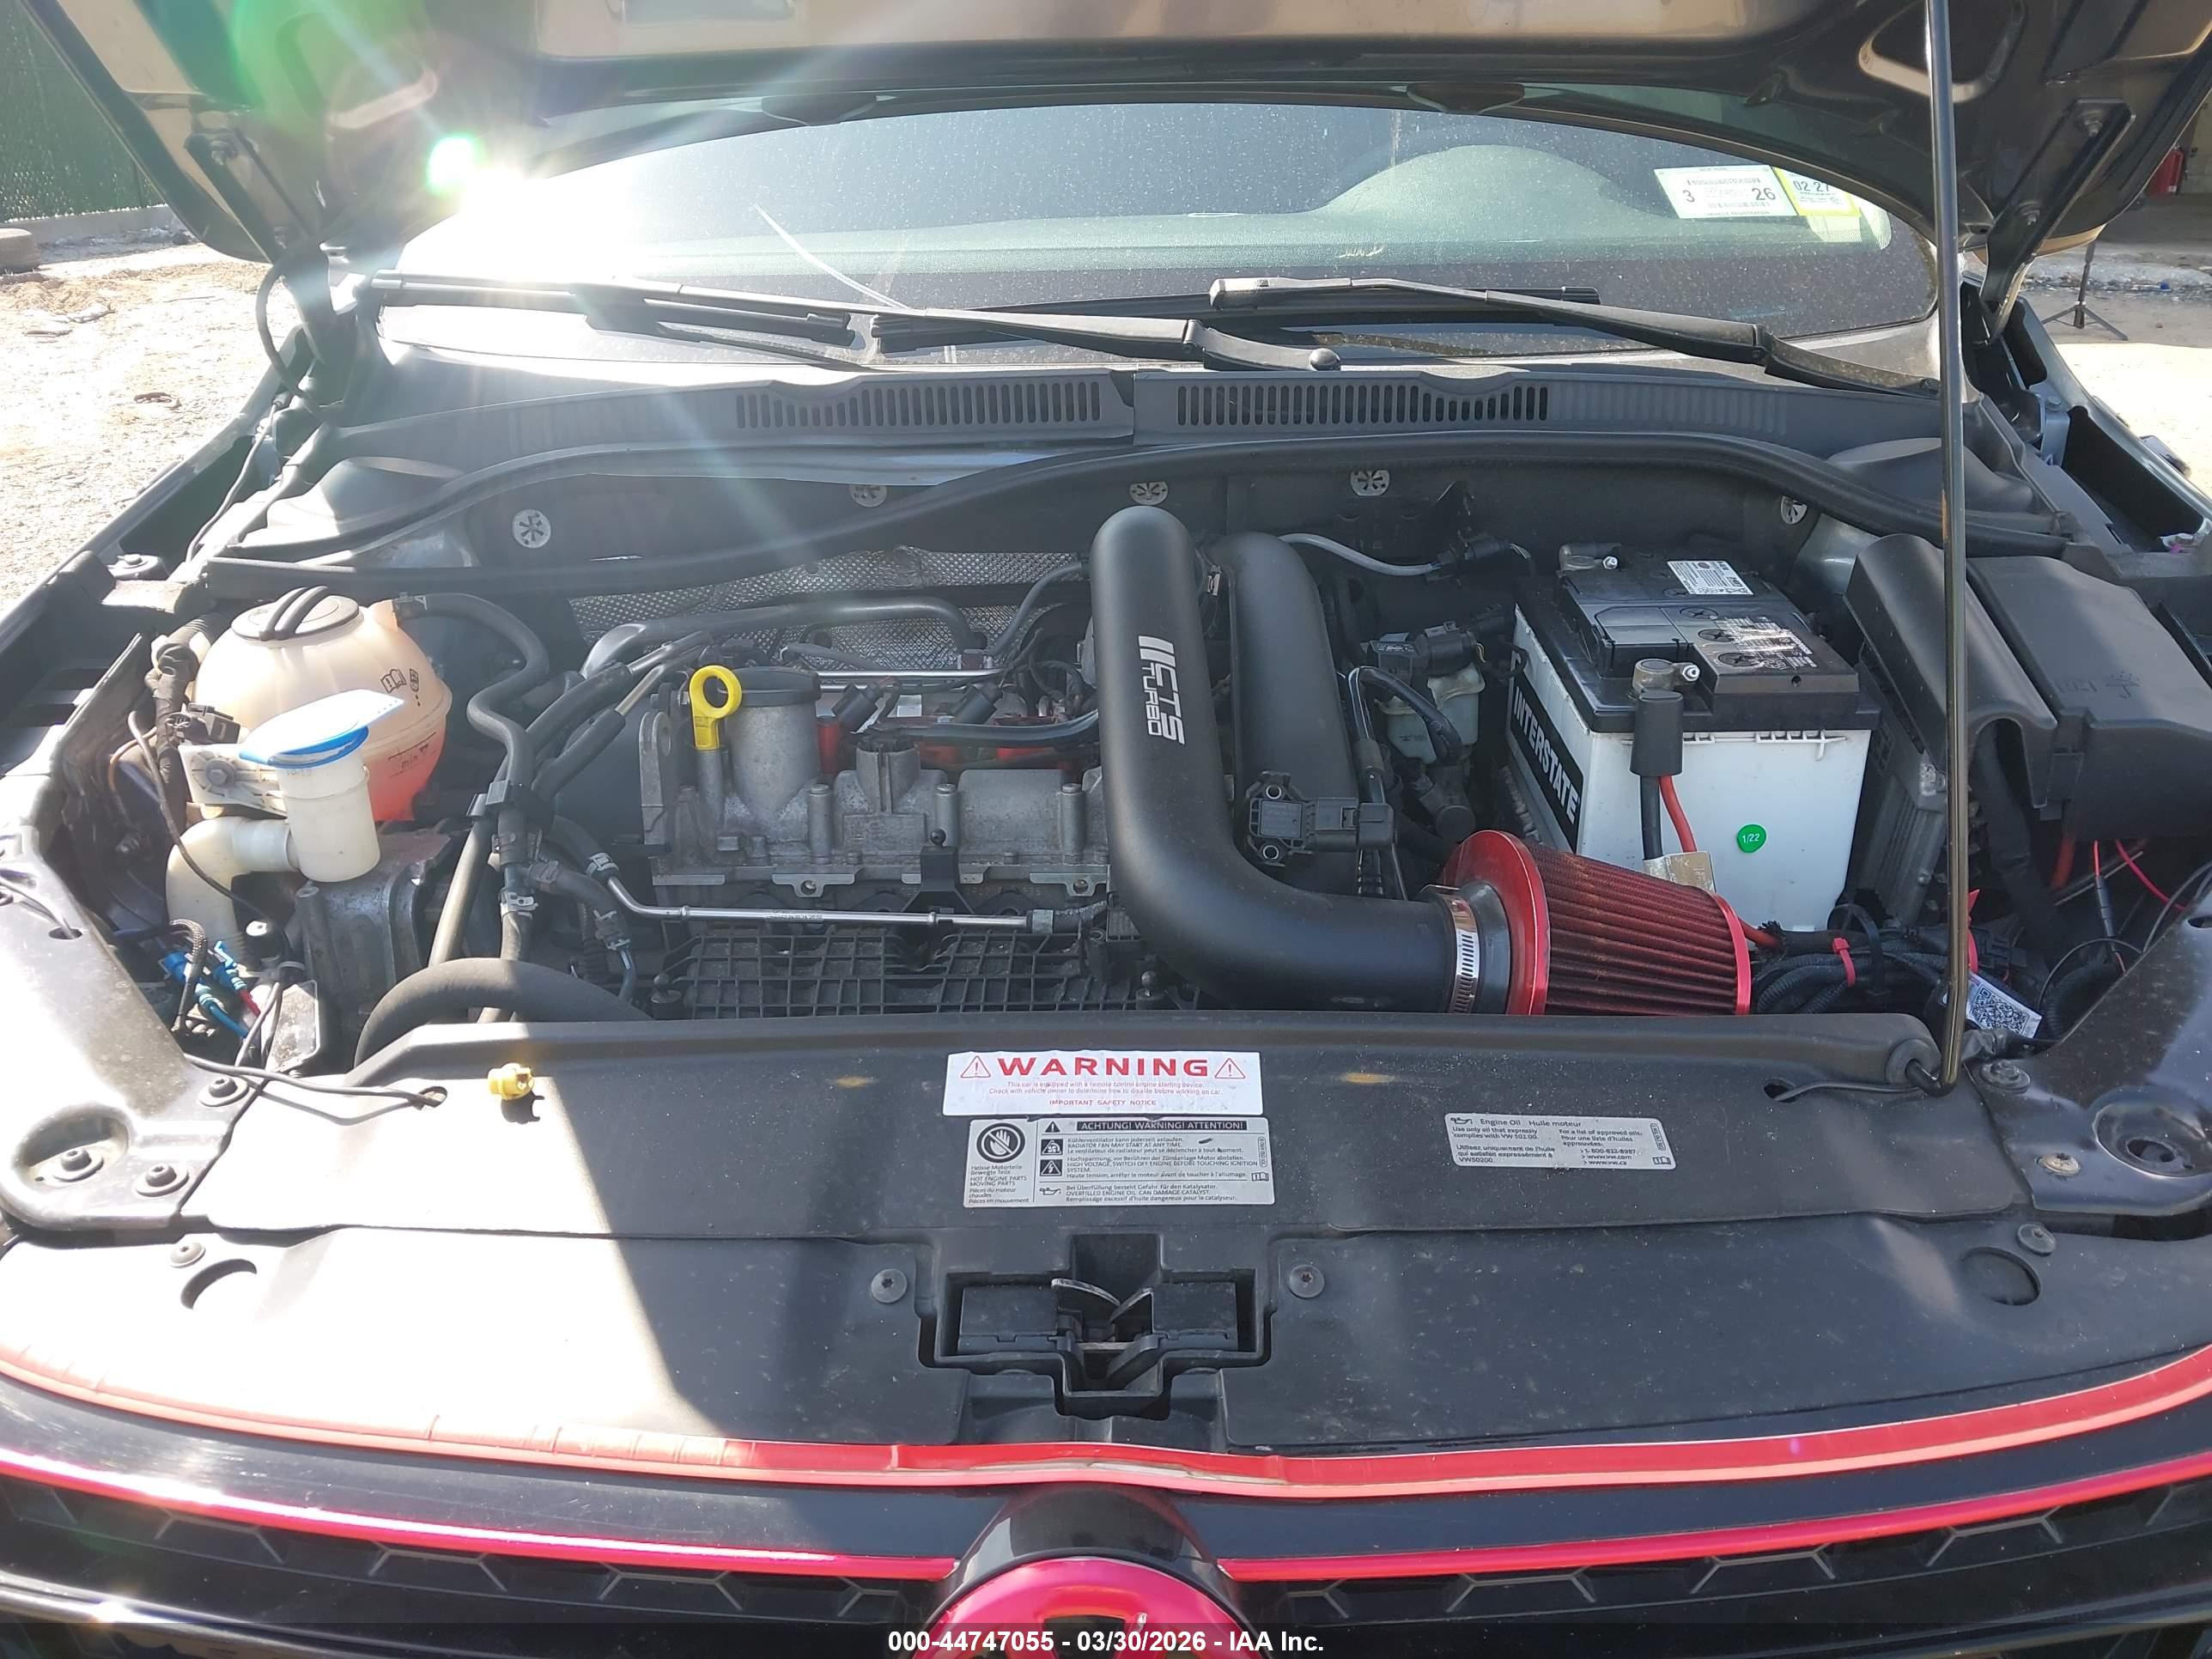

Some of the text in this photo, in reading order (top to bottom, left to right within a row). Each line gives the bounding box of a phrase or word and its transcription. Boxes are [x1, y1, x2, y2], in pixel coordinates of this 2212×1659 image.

[1683, 190, 1695, 203] 3
[1752, 187, 1776, 200] 26
[1141, 662, 1163, 736] TURBO
[1155, 662, 1186, 745] CTS
[401, 754, 419, 769] min
[1513, 685, 1580, 825] INTERSTATE
[1741, 833, 1760, 844] 1/22
[997, 1057, 1207, 1076] WARNING
